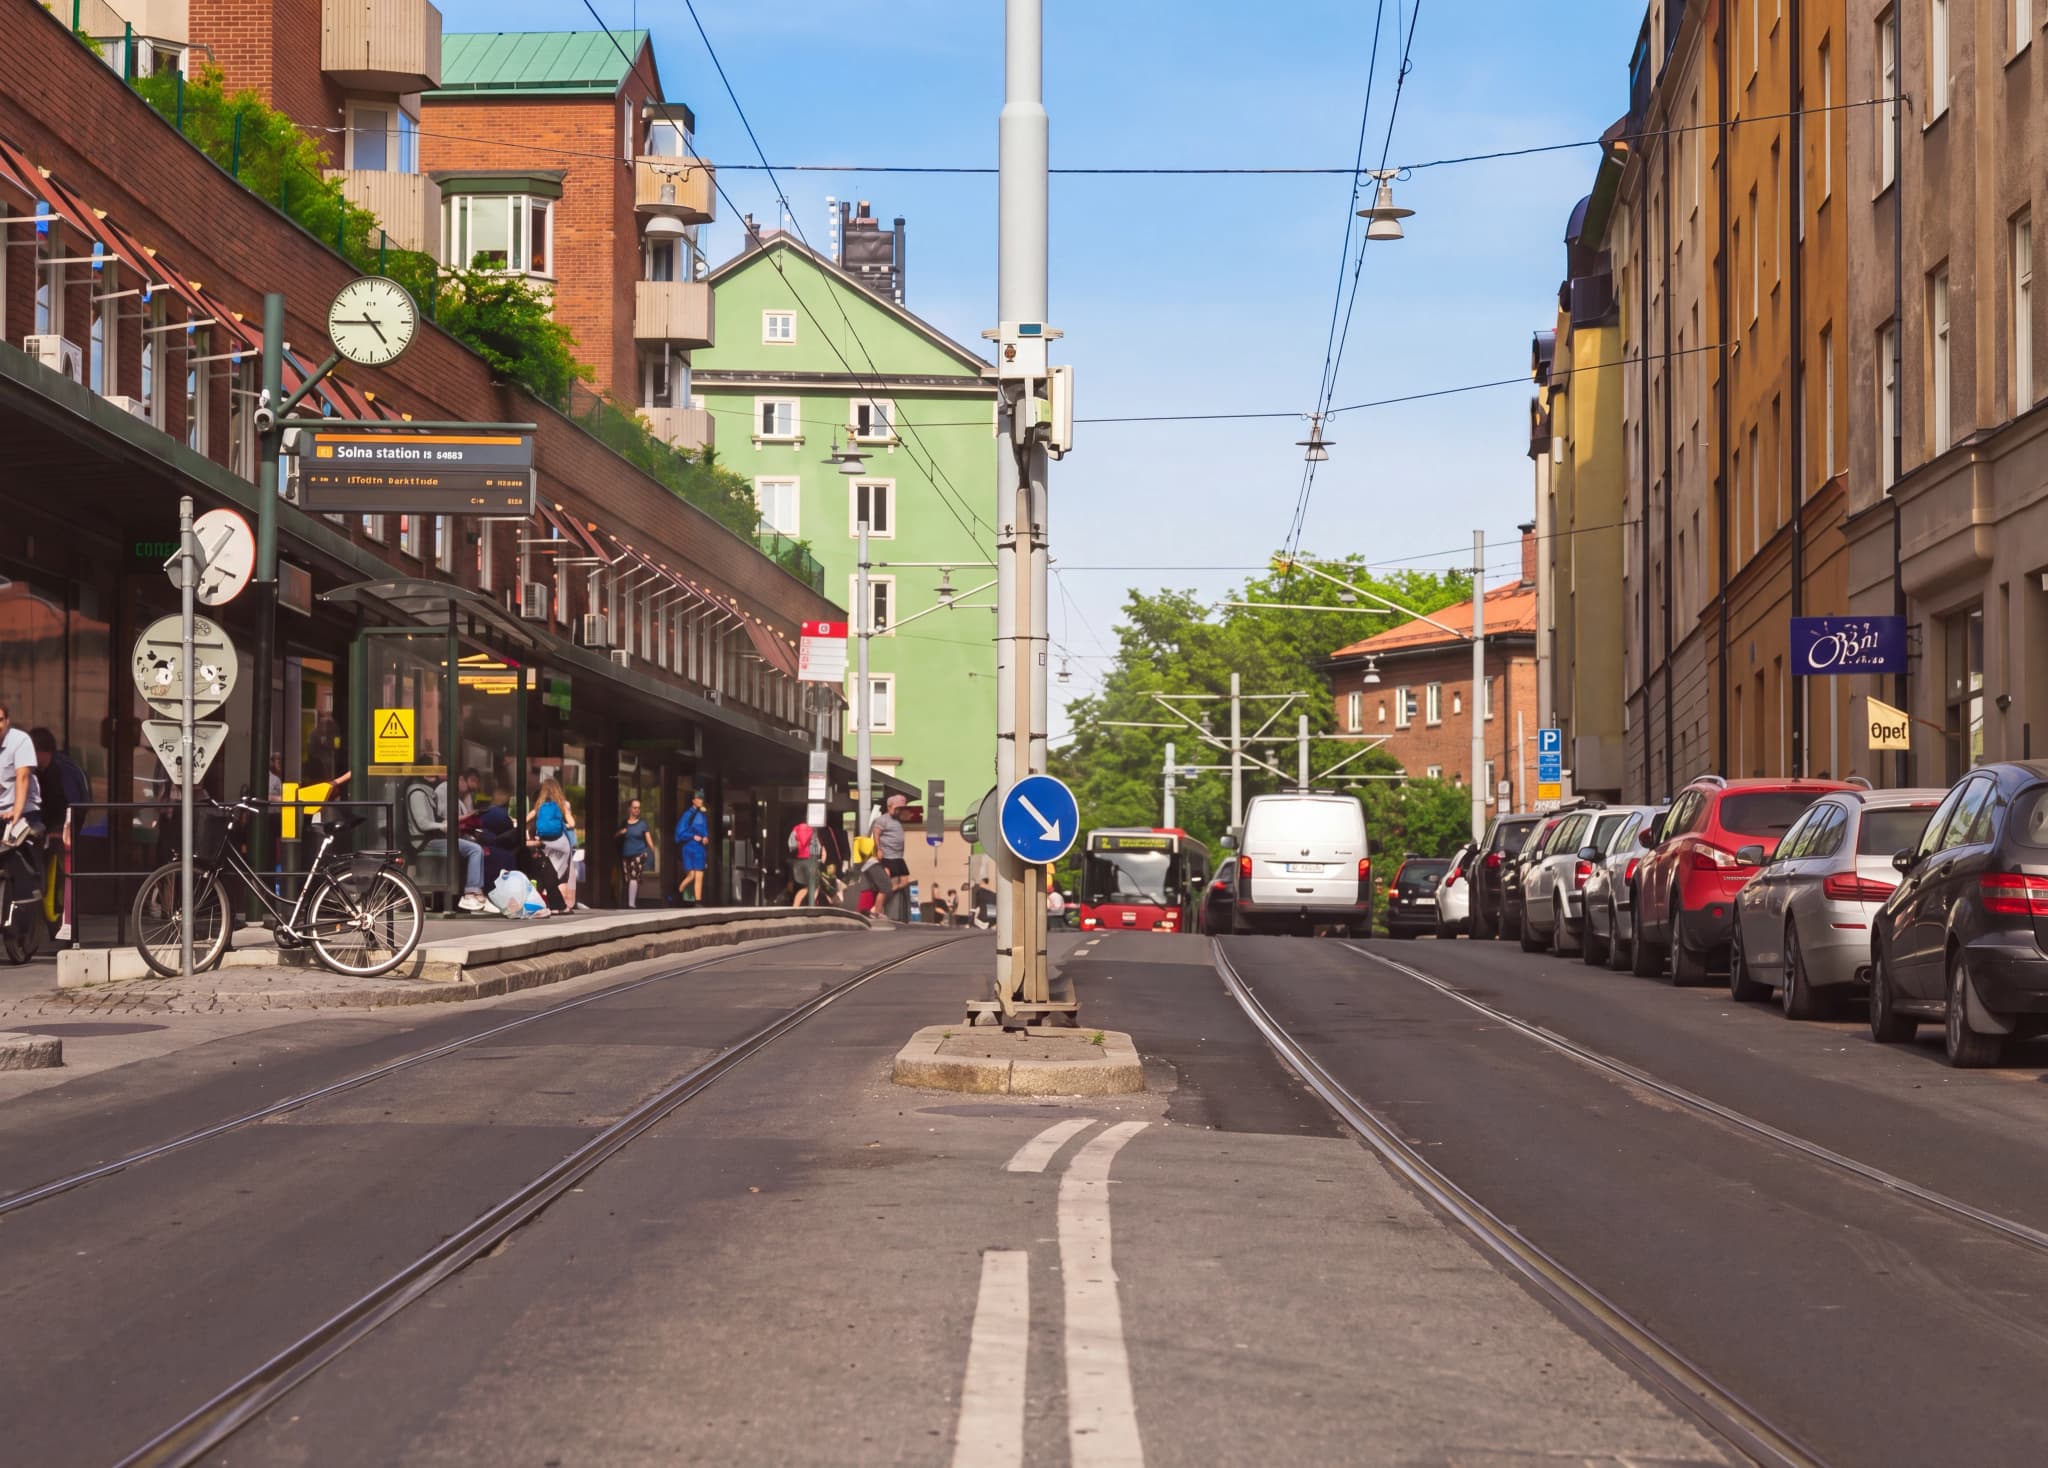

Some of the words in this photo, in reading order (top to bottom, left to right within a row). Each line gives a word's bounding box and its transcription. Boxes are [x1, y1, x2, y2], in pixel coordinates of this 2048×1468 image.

[337, 445, 373, 459] Solna
[376, 446, 420, 460] station
[1544, 731, 1557, 751] P
